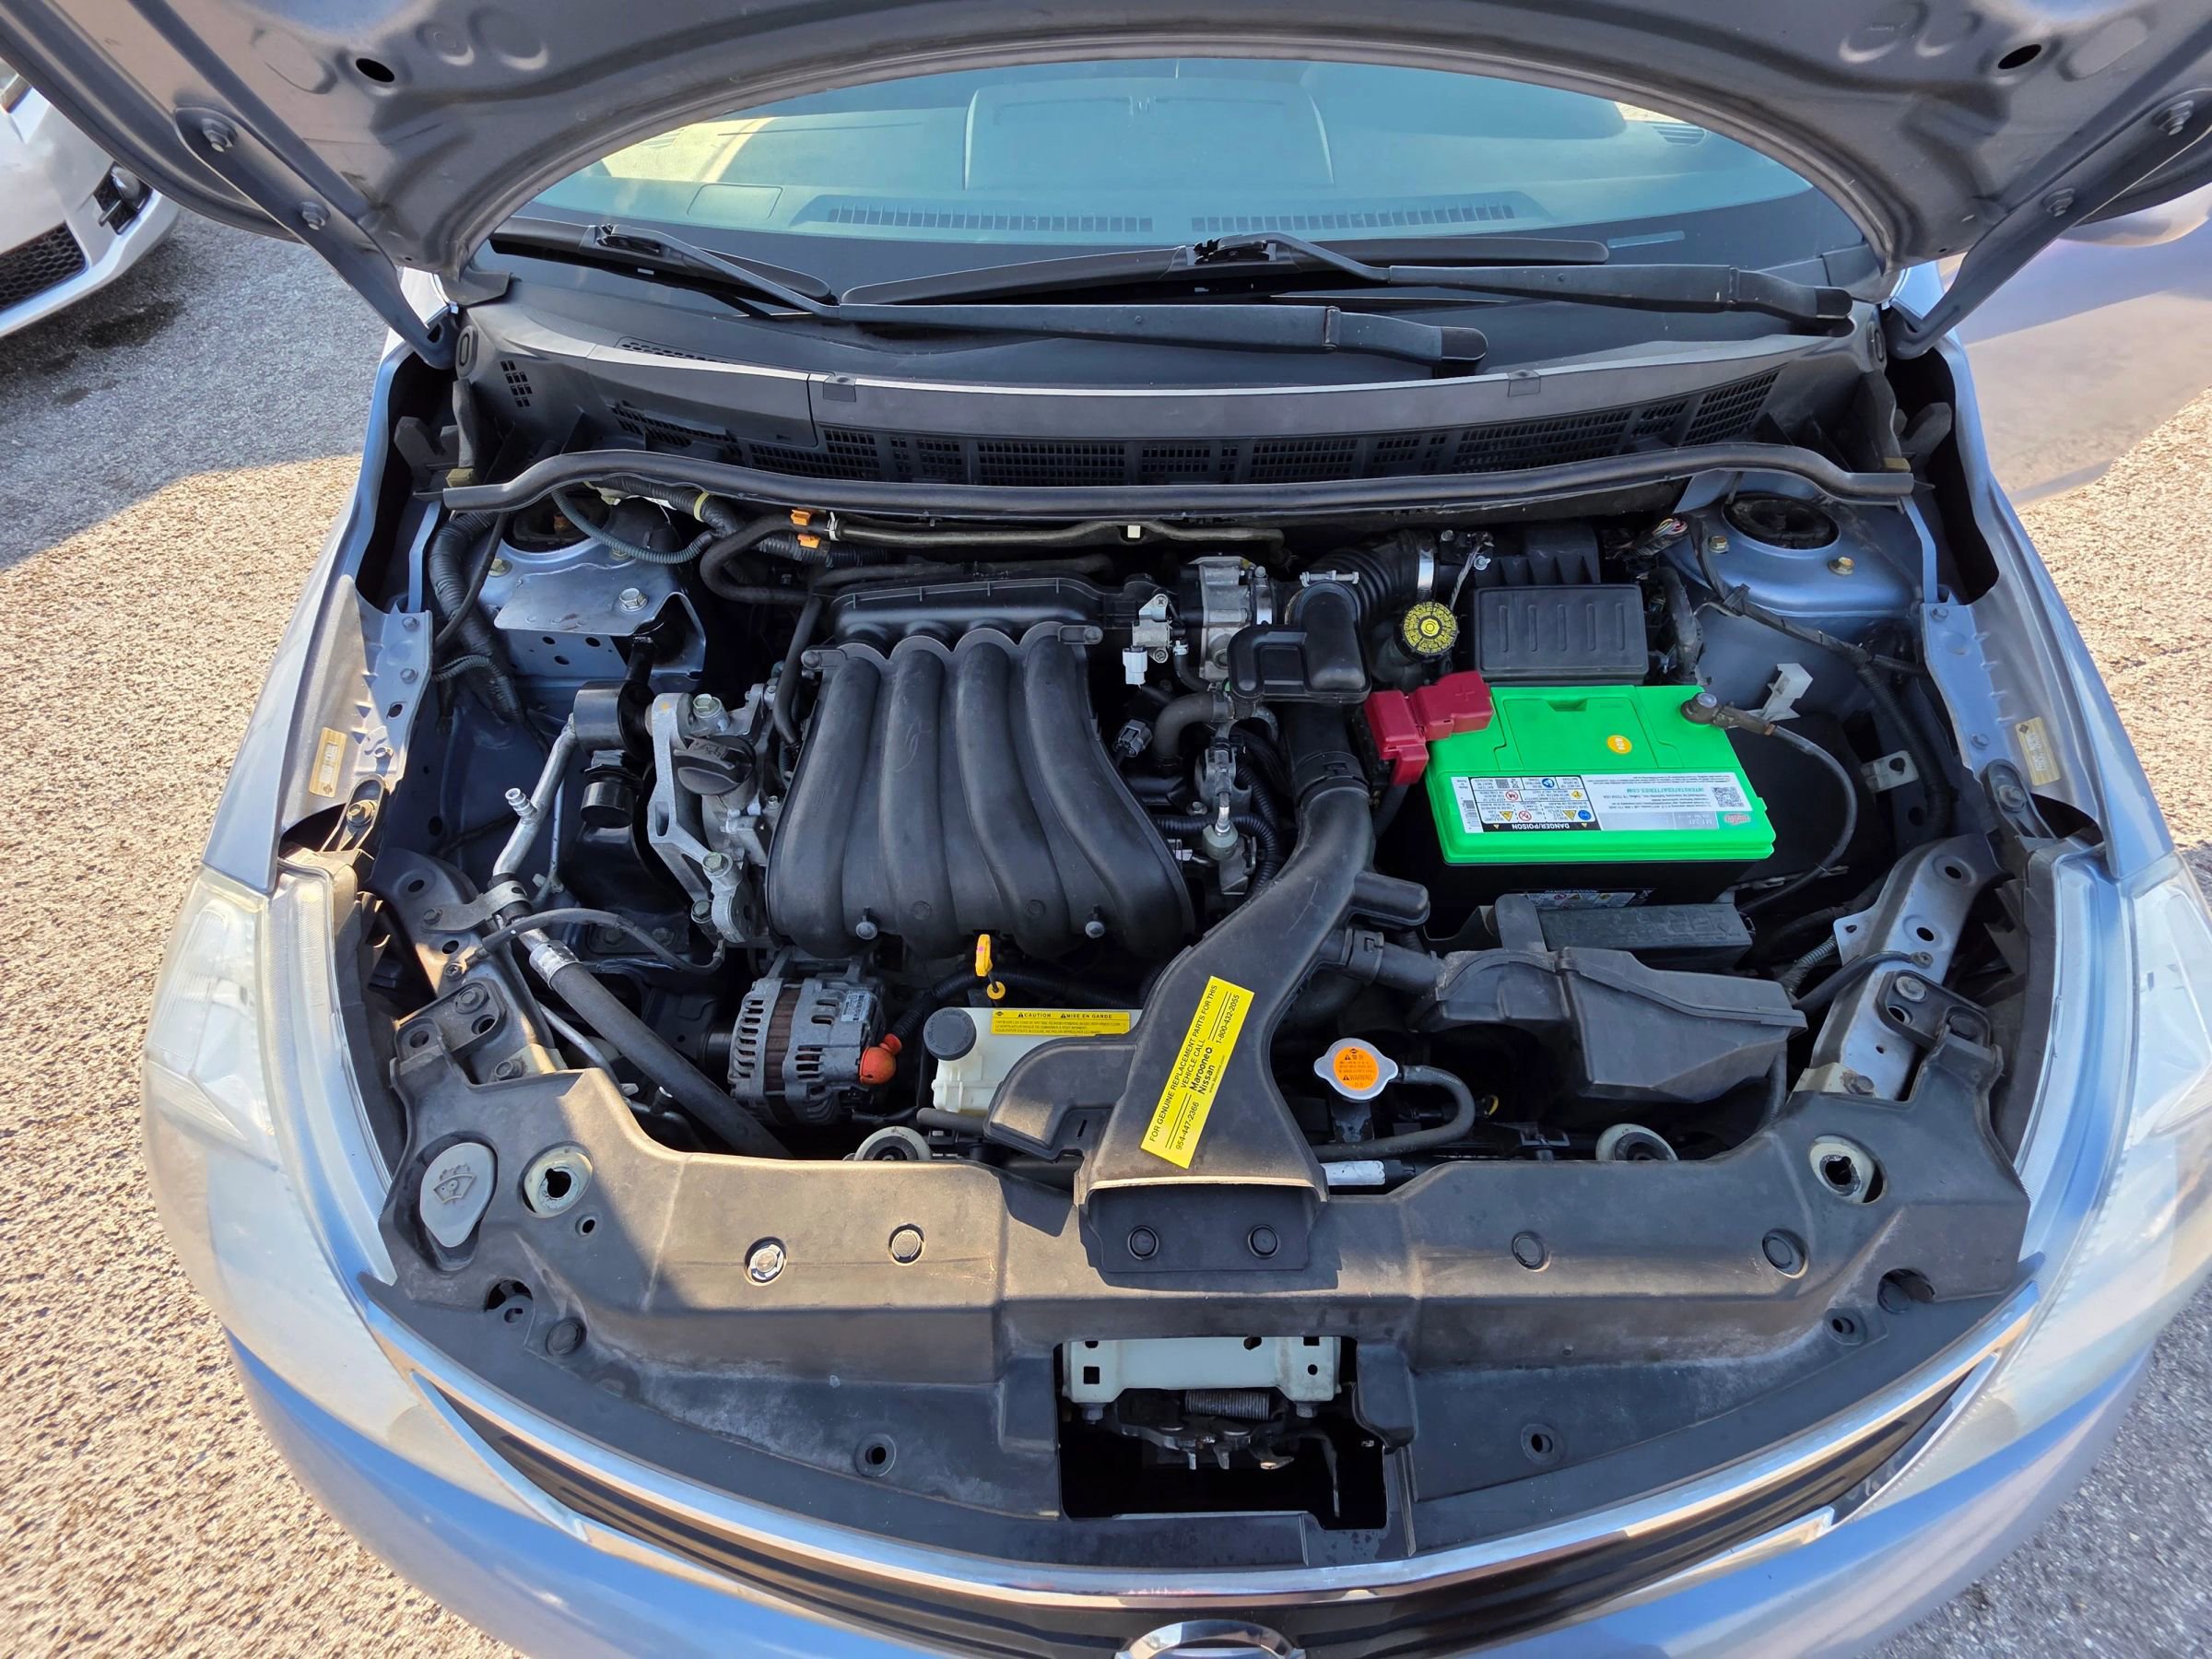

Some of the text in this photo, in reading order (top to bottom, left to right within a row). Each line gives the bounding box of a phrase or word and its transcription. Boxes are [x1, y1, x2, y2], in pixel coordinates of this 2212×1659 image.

[1216, 994, 1240, 1044] 1-800-432-2055
[1149, 985, 1218, 1142] FOR GENUINE REPLACEMENT PARTS FOR THIS
[1181, 1040, 1205, 1088] VEHICLE CALL
[1197, 1065, 1216, 1095] Nissan
